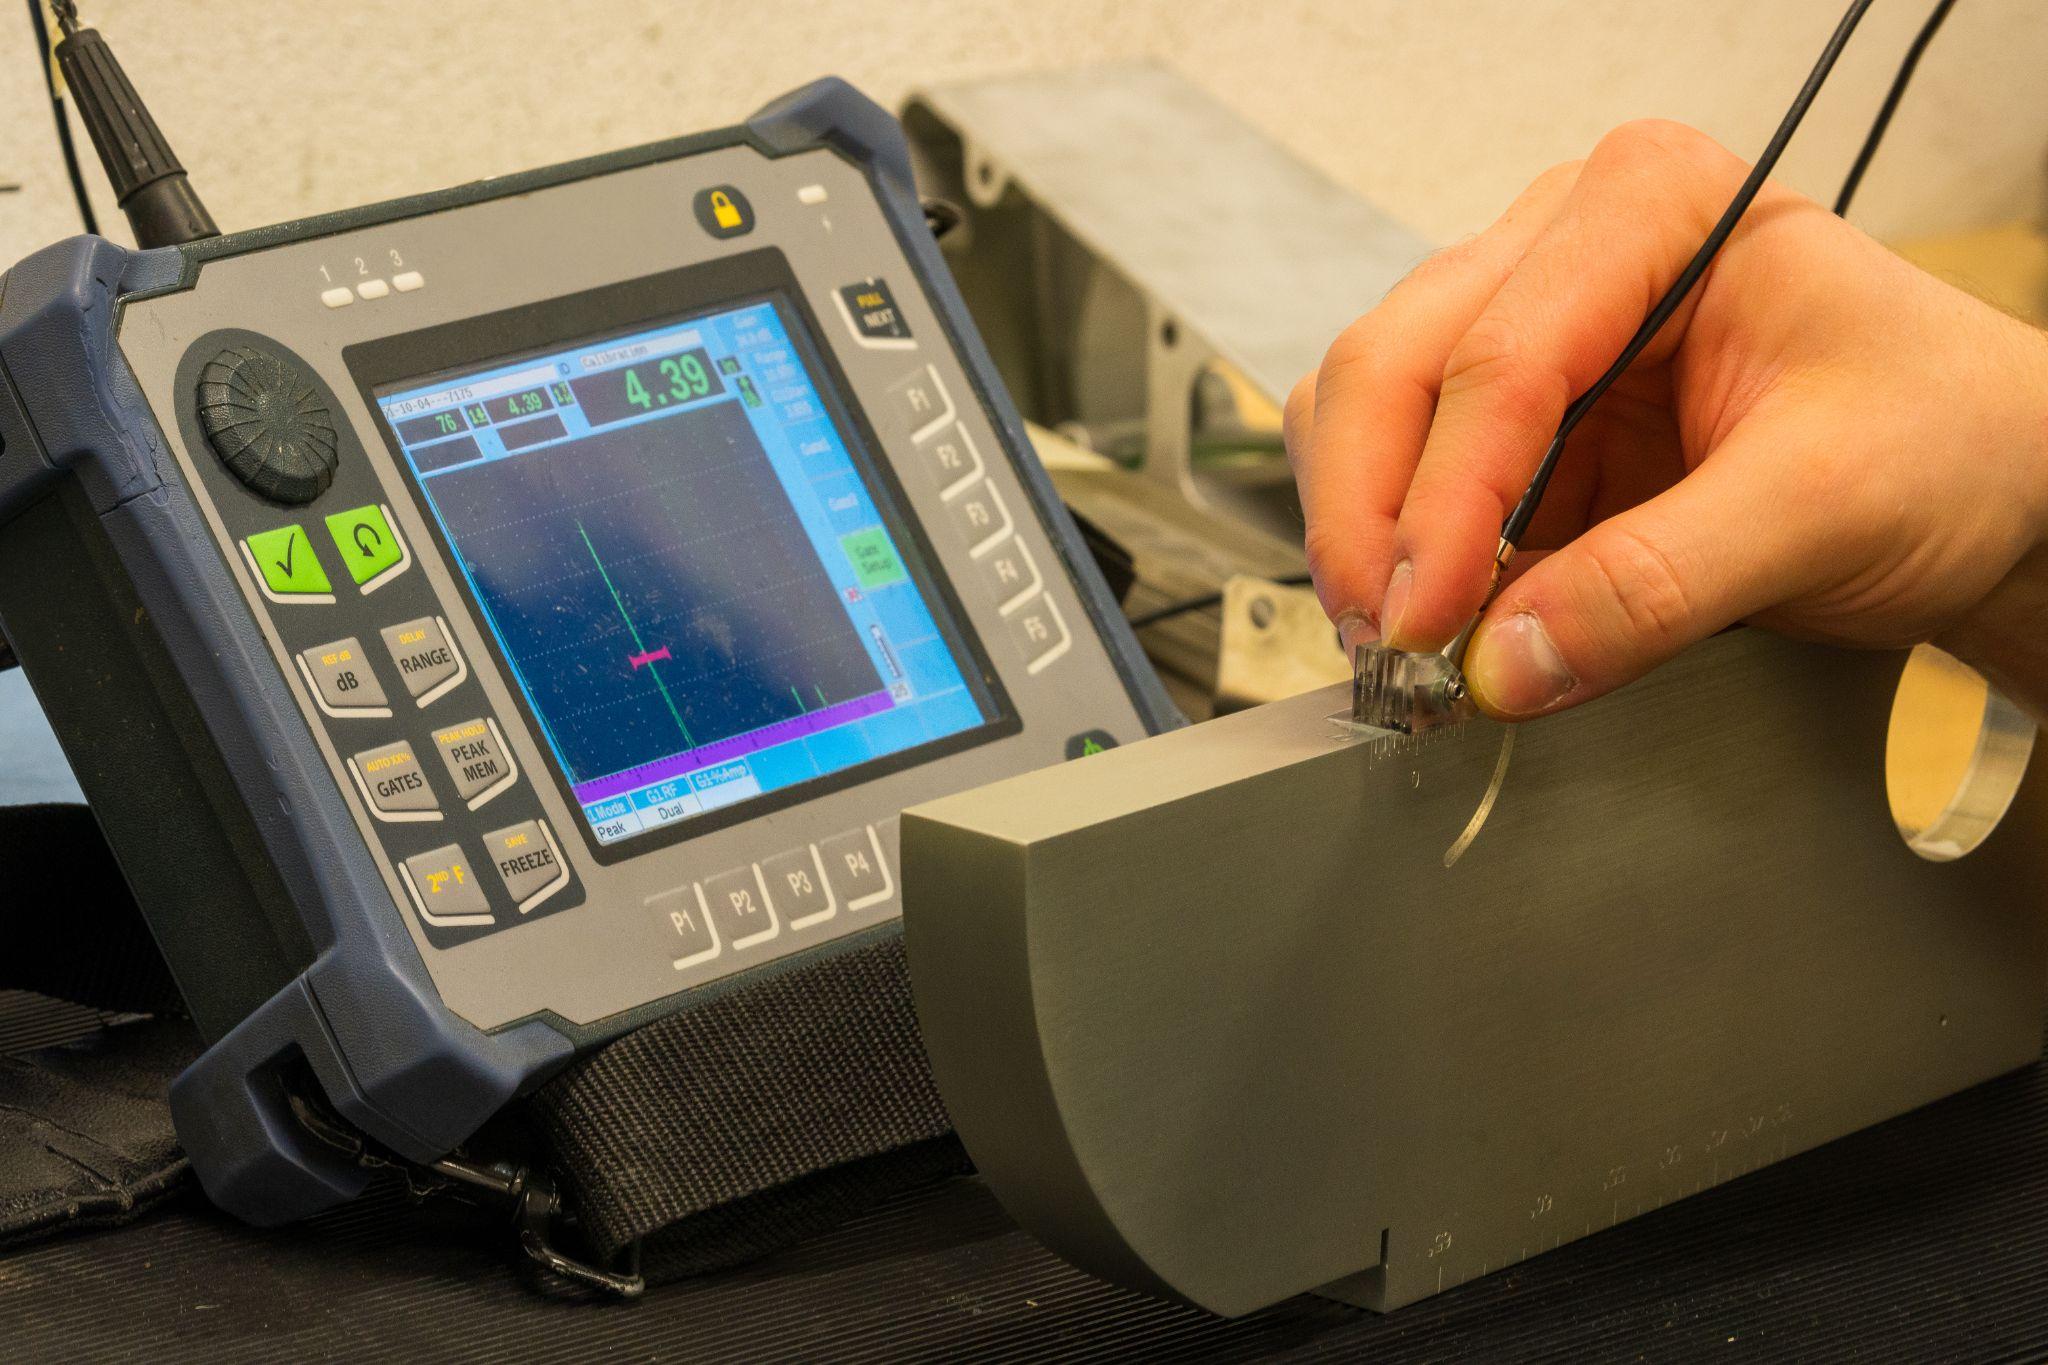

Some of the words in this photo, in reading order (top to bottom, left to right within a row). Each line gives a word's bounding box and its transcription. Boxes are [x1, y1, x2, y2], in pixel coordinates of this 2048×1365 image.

[320, 264, 331, 282] 1
[355, 257, 368, 275] 2
[390, 249, 403, 267] 3
[581, 345, 647, 368] Calibration
[625, 354, 710, 409] 4.39
[508, 392, 543, 415] 4.39
[435, 413, 457, 433] 76
[936, 444, 961, 469] F2
[965, 502, 990, 527] F3
[994, 558, 1019, 583] F4
[399, 629, 426, 645] DELAY
[1023, 616, 1048, 642] F5
[322, 653, 338, 667] REF
[400, 647, 451, 674] RANGE
[336, 671, 359, 692] dB
[439, 732, 463, 745] PEAK
[462, 724, 486, 738] HOLD
[451, 740, 490, 763] PEAK
[367, 756, 391, 772] AUTO
[463, 760, 498, 782] MEM
[377, 771, 423, 797] GATES
[597, 802, 626, 819] Mode
[658, 803, 685, 820] Dual
[504, 833, 528, 848] SAVE
[597, 821, 626, 839] Peak
[453, 865, 465, 884] F
[500, 849, 553, 878] FREEZE
[844, 850, 871, 877] P4
[786, 870, 813, 897] P3
[729, 889, 756, 916] P2
[670, 909, 696, 936] P1
